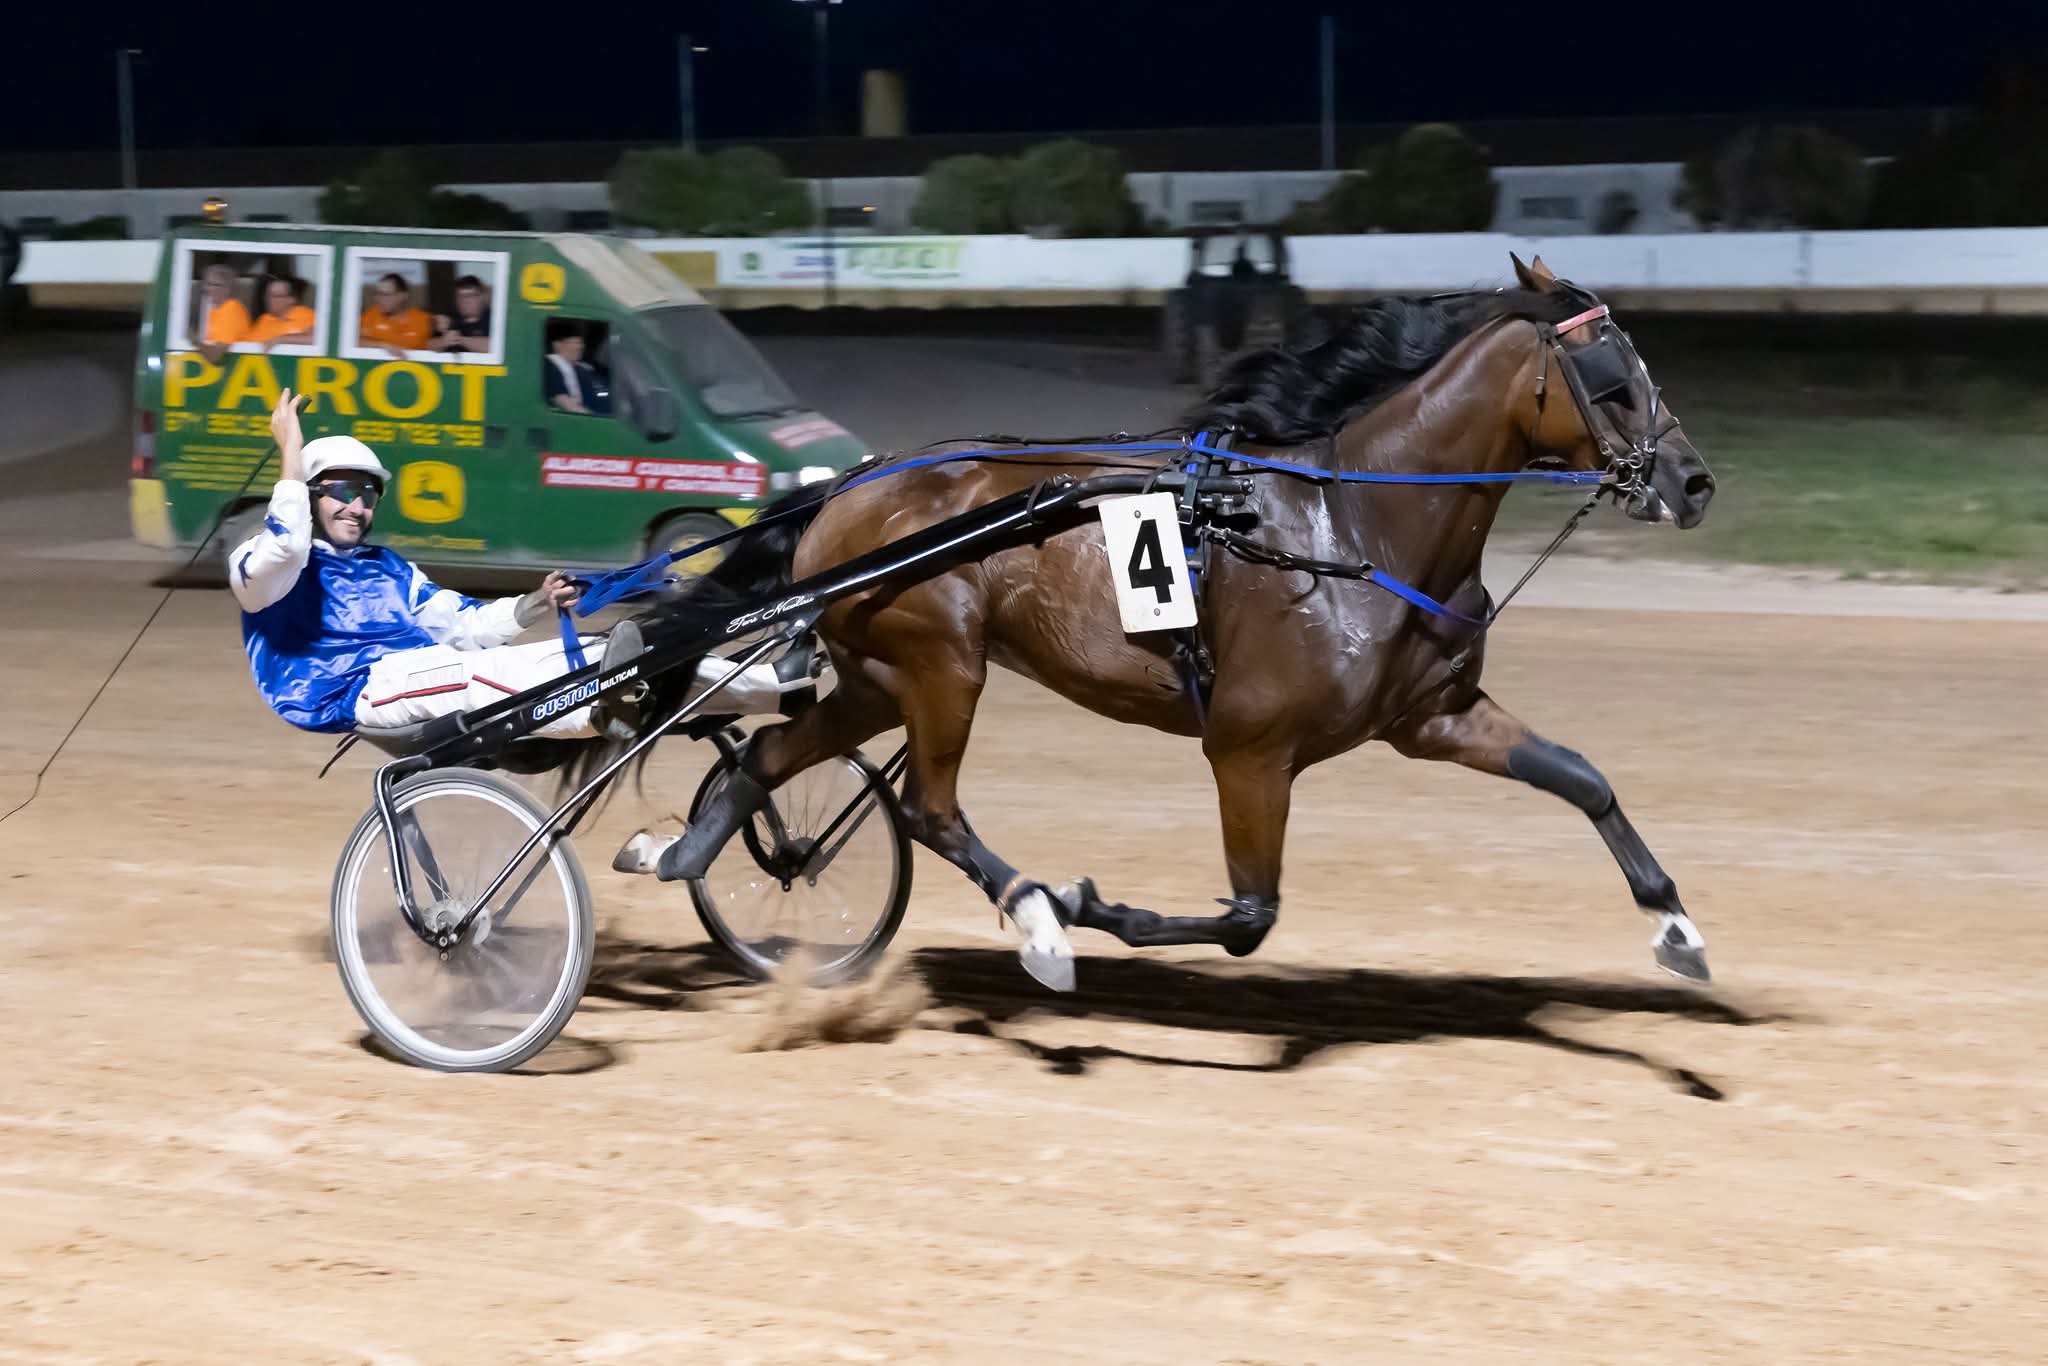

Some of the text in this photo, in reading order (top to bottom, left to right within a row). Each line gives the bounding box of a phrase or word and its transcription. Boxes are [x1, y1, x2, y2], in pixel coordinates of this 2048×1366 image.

[163, 352, 508, 422] PAROT
[1128, 519, 1175, 604] 4
[532, 665, 638, 720] CUSTOM MULTICAM
